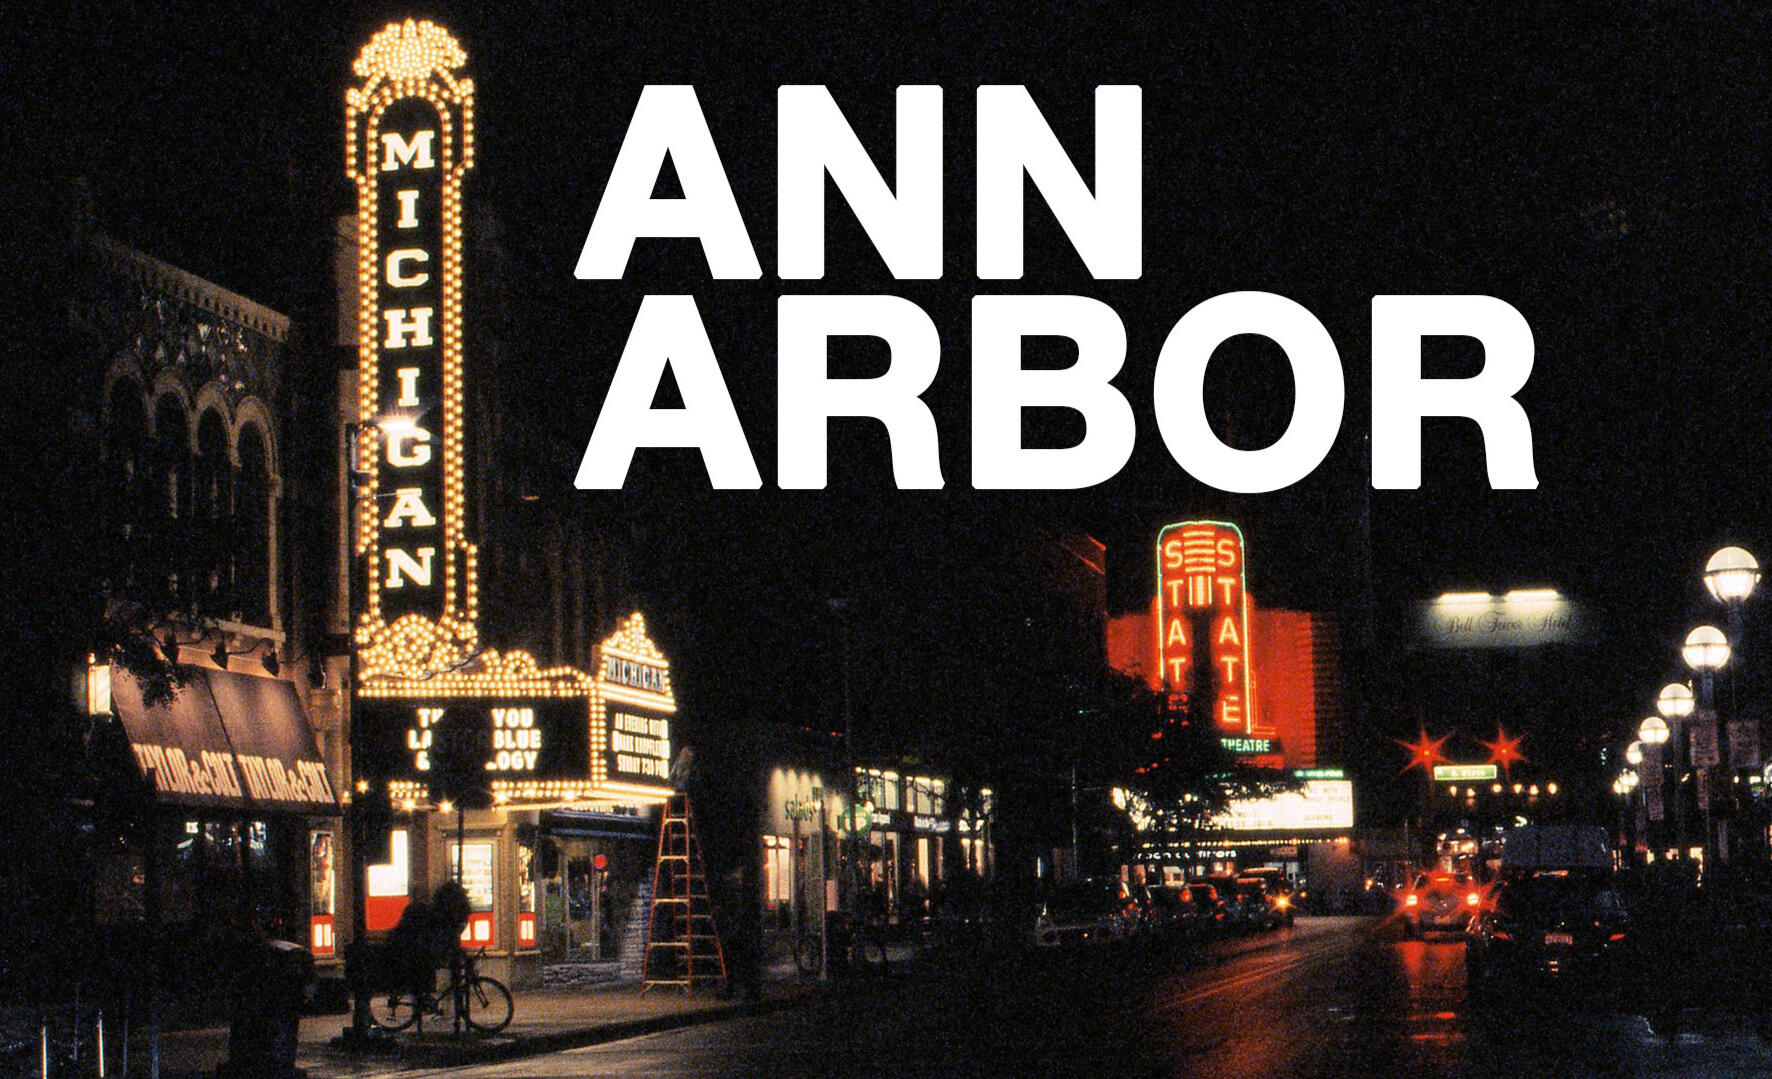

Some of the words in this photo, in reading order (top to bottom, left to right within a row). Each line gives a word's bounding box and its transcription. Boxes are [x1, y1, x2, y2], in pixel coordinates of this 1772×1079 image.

[381, 130, 436, 587] MICHIGAN
[1216, 539, 1241, 723] STATE
[606, 655, 666, 693] MICHIGAN
[491, 707, 533, 728] YOU
[493, 729, 541, 750] BLUE
[1220, 738, 1270, 752] THEATRE
